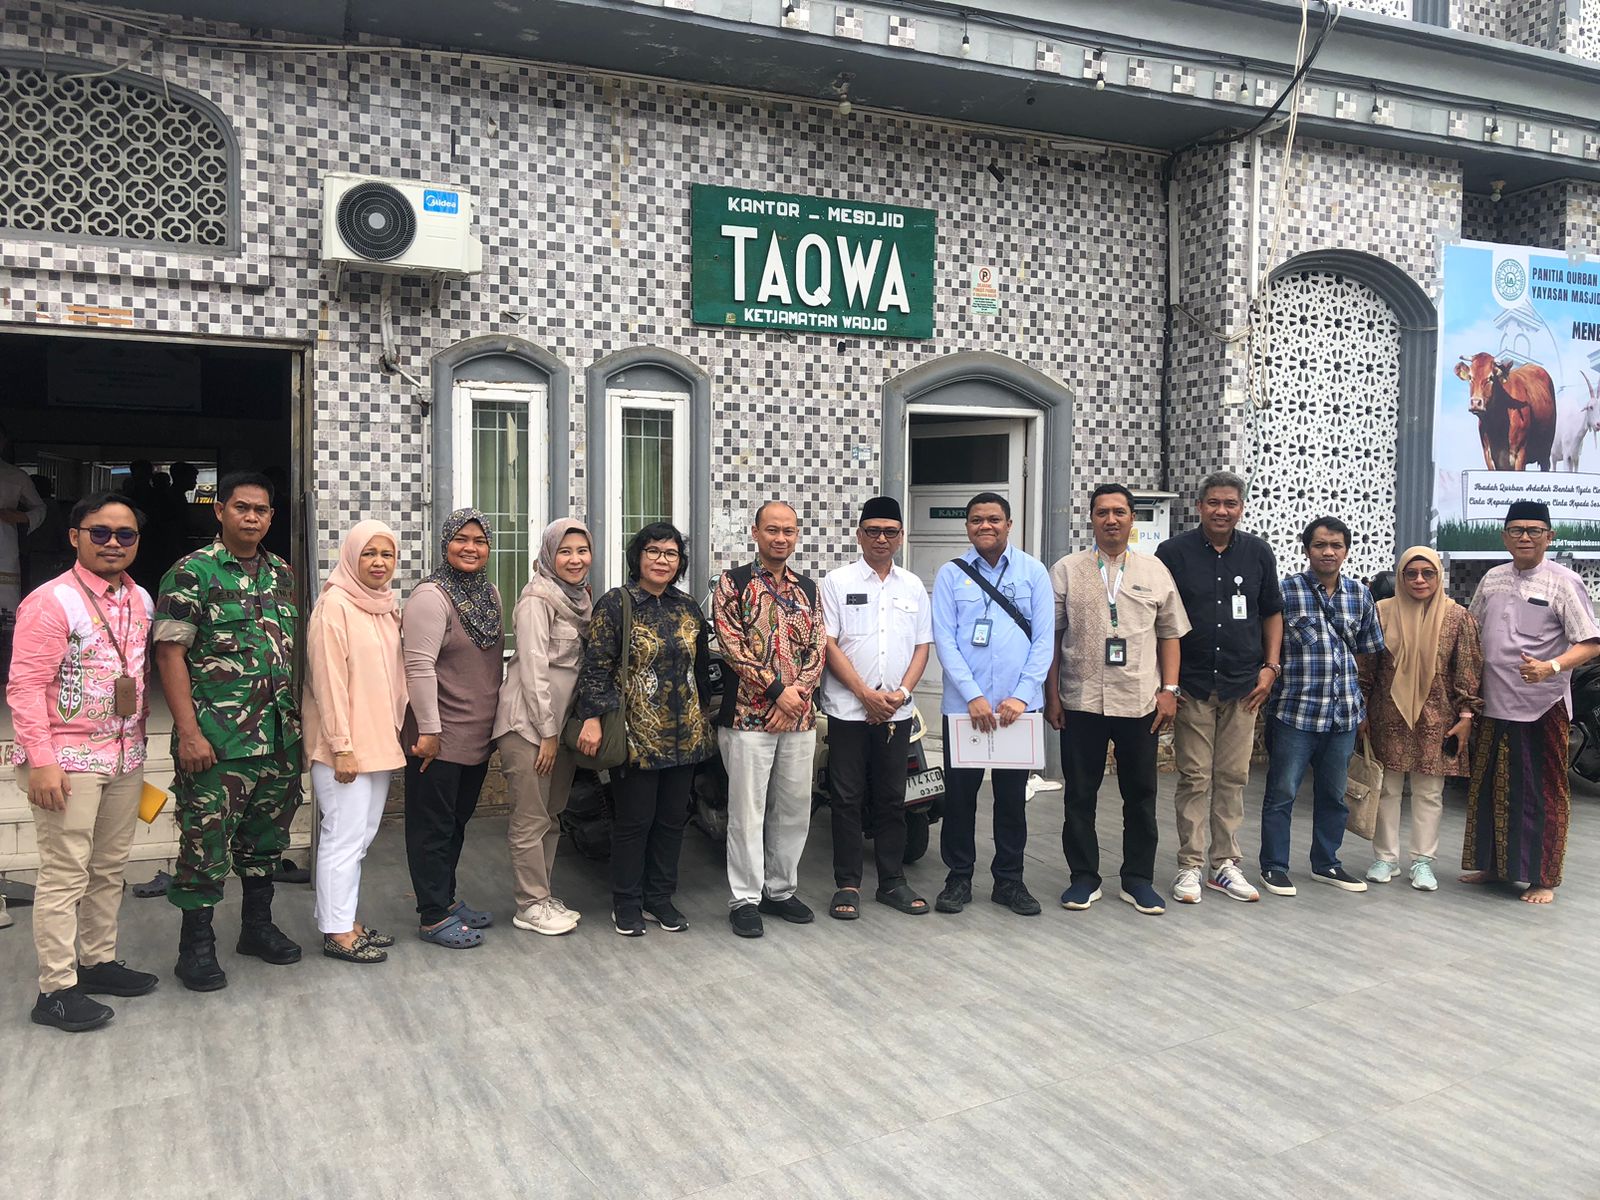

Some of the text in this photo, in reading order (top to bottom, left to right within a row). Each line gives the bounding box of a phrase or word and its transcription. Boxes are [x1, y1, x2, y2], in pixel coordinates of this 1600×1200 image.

[426, 195, 456, 208] Midea
[728, 197, 800, 218] KANTOR
[828, 206, 905, 228] MESDJID
[721, 225, 911, 313] TAQWA
[1532, 267, 1597, 286] PANITIA QURBAN
[1532, 286, 1568, 301] YAYASAN
[744, 308, 888, 331] KETJAMATAN WADJO
[1499, 483, 1524, 492] Qurban
[1525, 484, 1551, 492] Adalah
[1139, 531, 1161, 540] PLN
